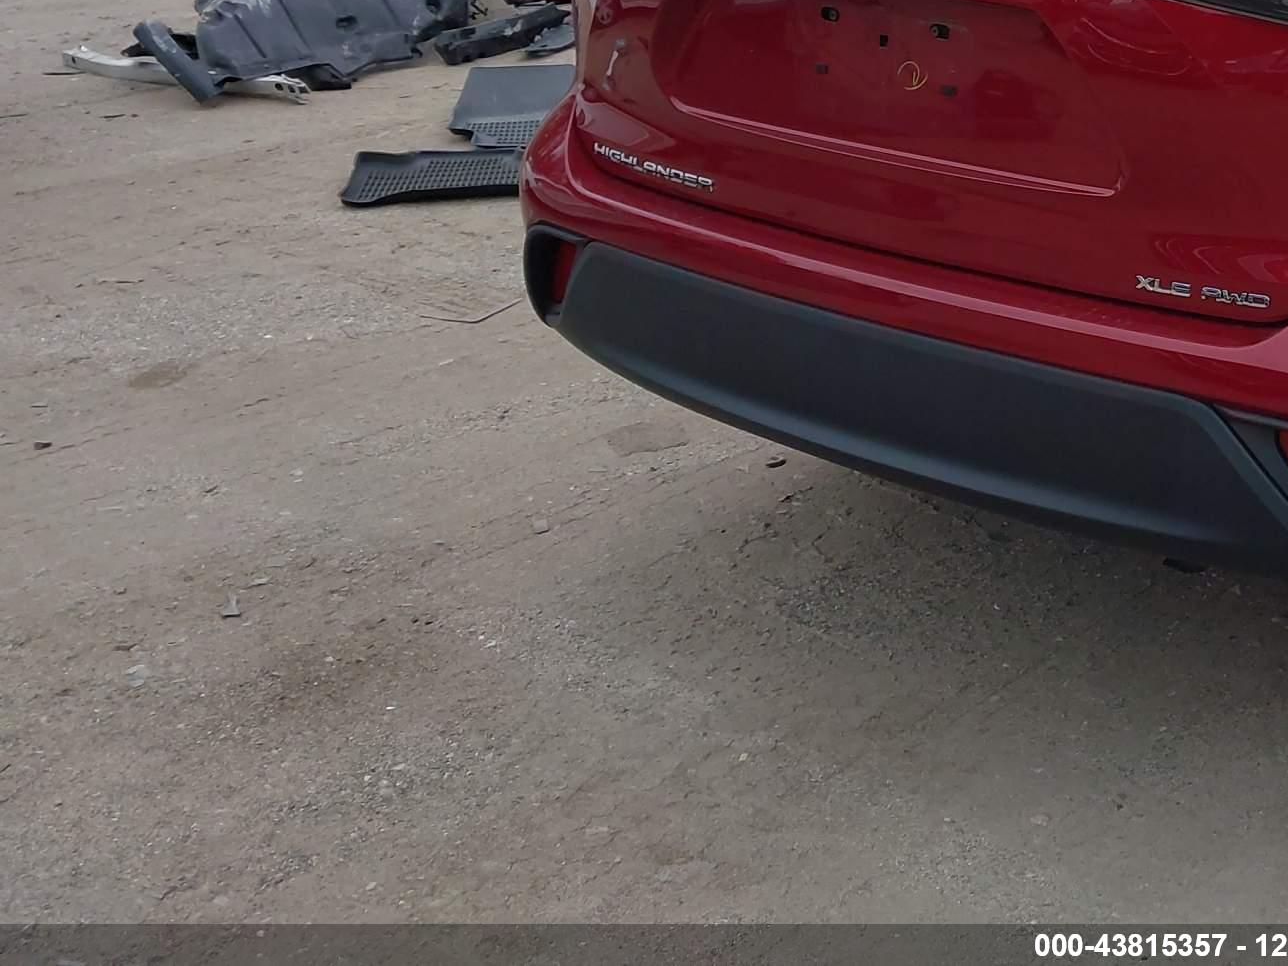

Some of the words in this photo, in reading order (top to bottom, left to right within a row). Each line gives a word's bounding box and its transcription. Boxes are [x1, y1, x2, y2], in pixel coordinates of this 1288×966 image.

[593, 142, 713, 192] HIGHLANDER
[1135, 275, 1191, 298] XLE
[1201, 286, 1271, 309] AWD
